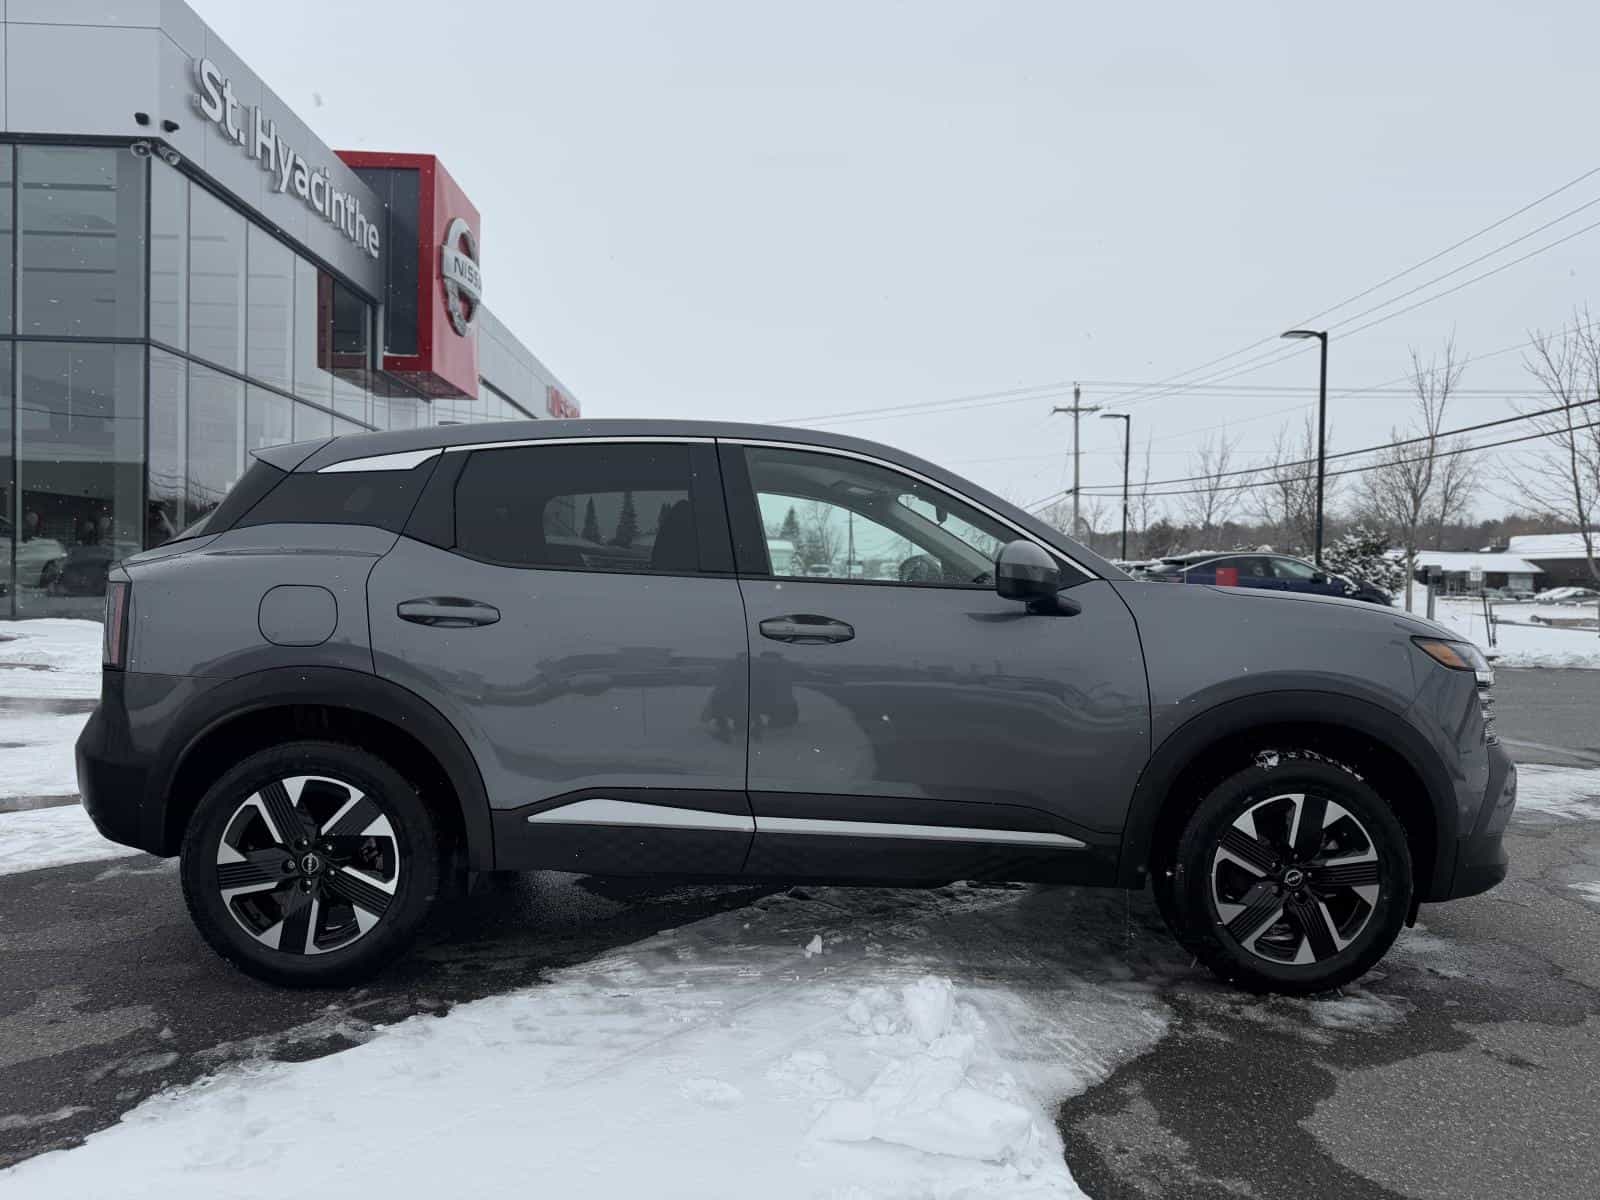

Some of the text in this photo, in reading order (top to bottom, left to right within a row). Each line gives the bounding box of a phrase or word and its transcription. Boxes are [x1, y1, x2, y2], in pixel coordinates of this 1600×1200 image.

[195, 58, 380, 259] St. Hyacinthe
[453, 255, 481, 290] NISS
